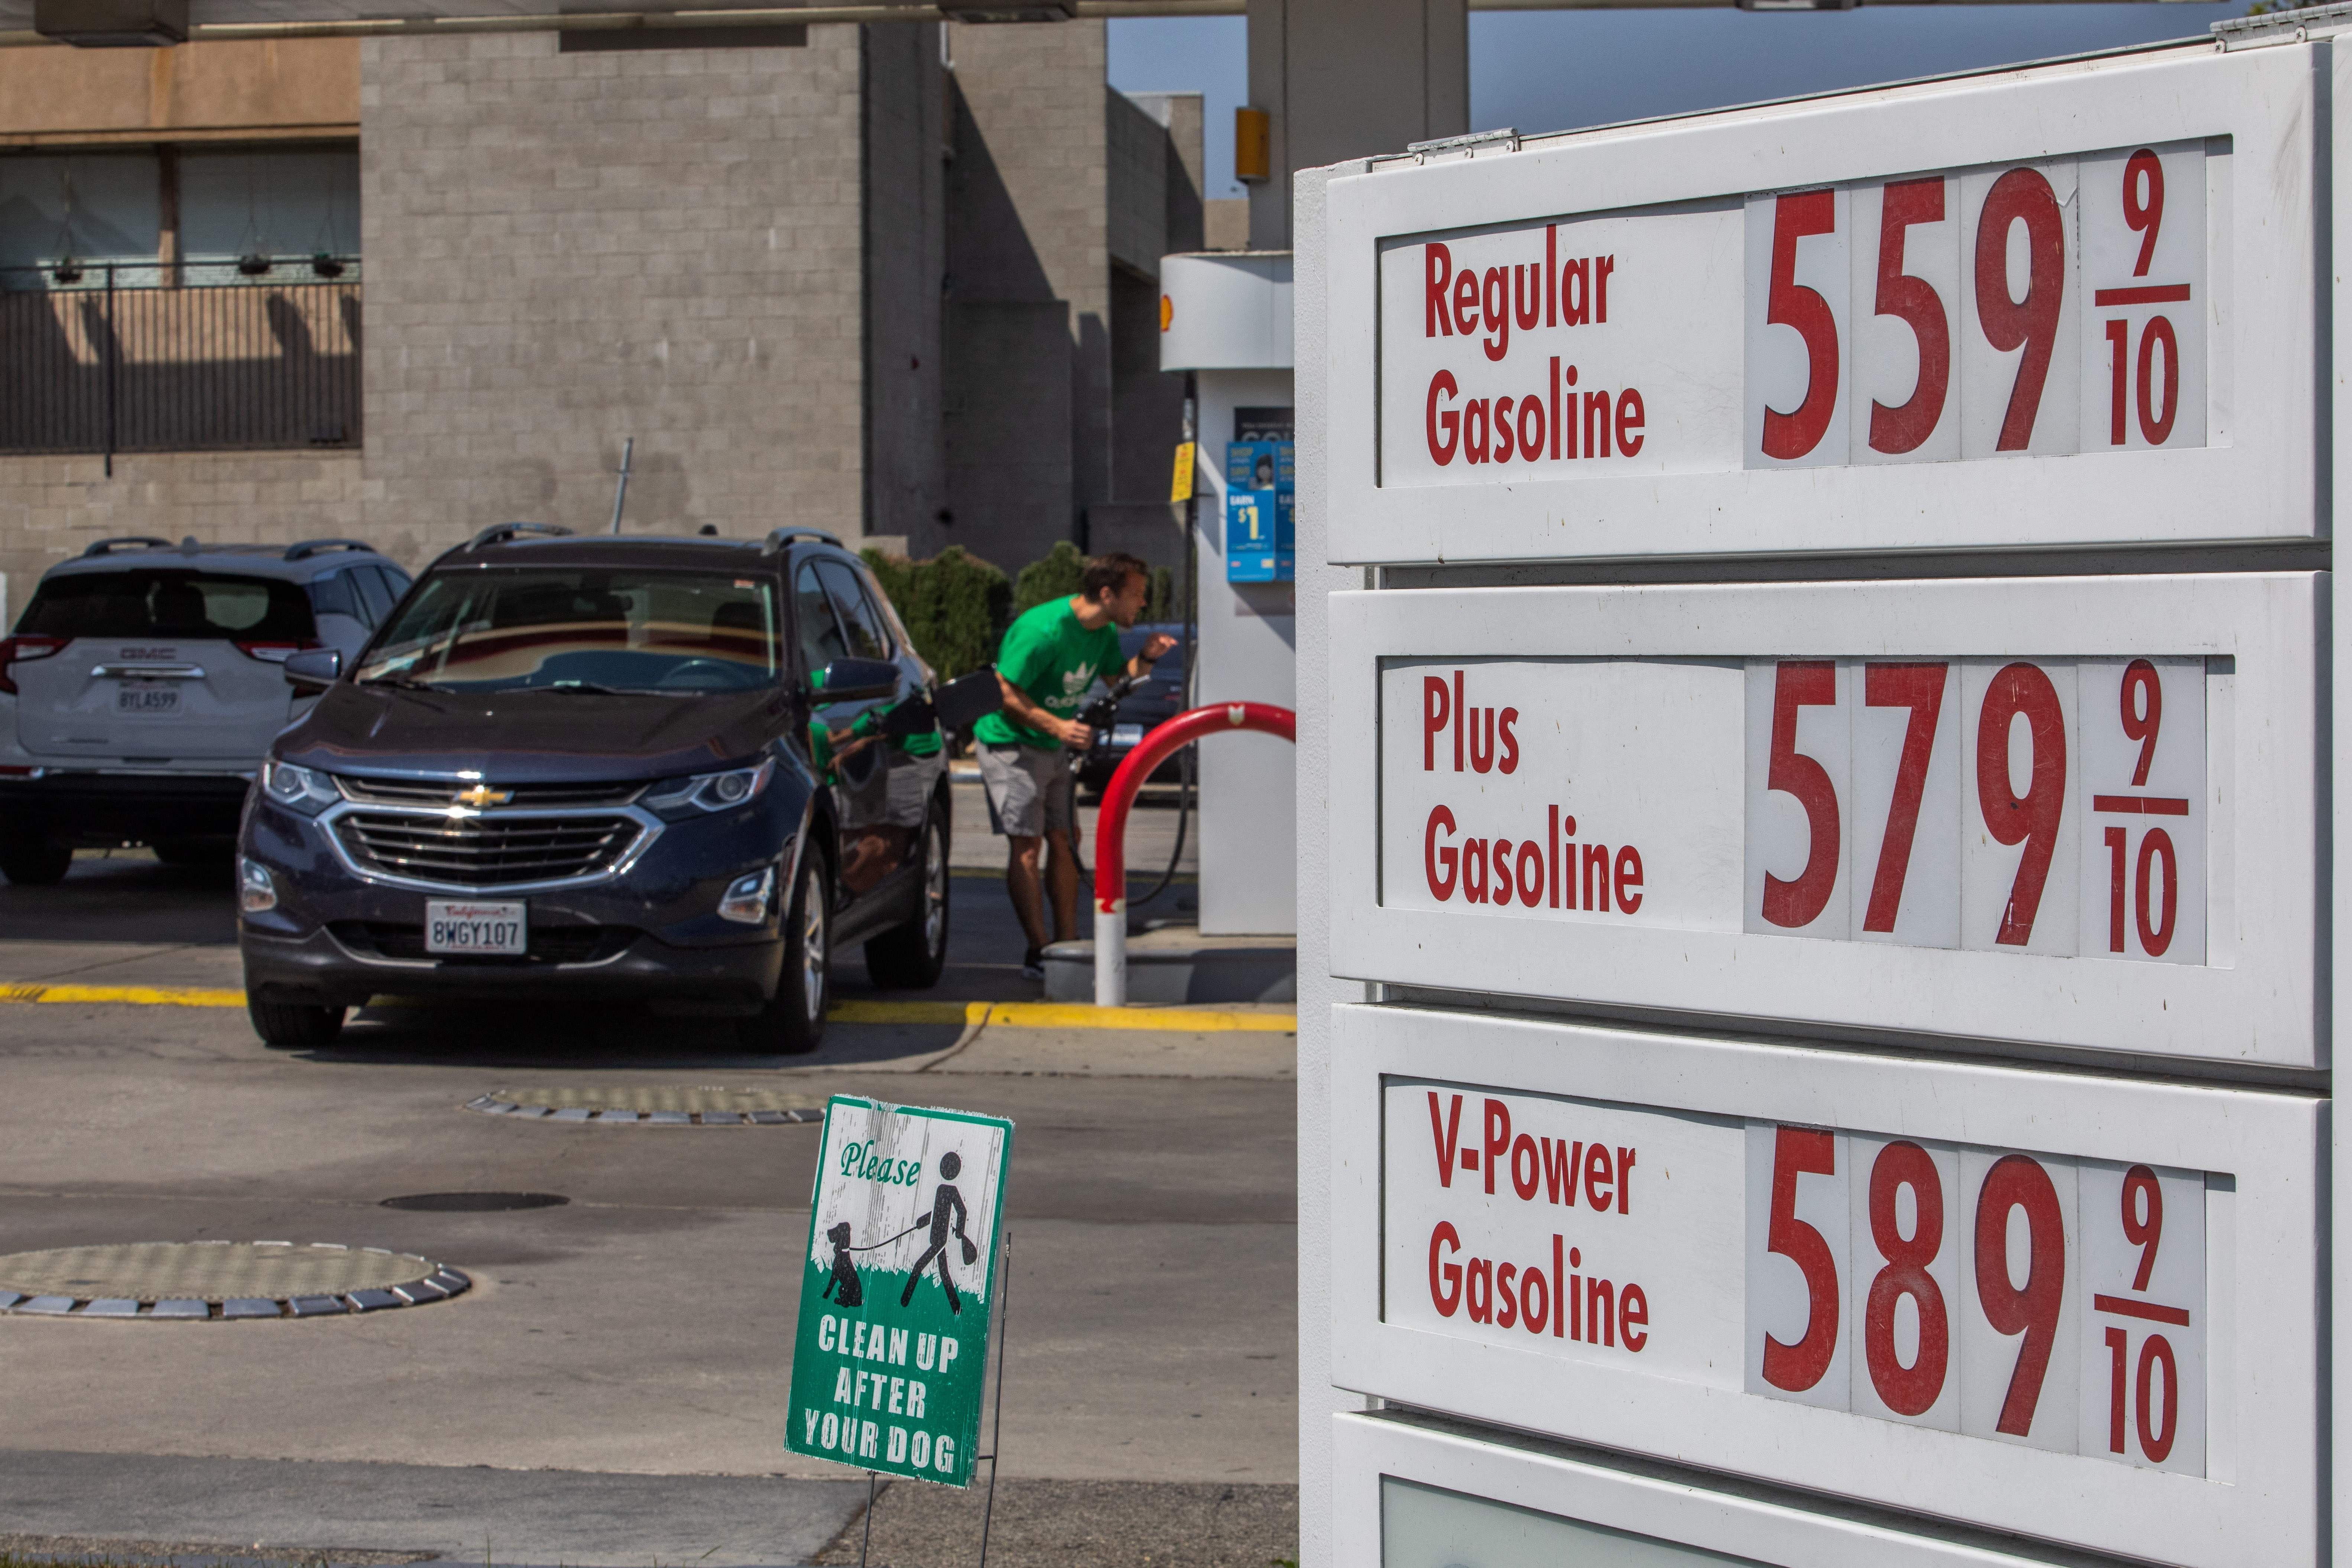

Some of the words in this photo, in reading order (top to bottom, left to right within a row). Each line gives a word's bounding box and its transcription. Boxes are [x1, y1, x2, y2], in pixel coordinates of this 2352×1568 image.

[2122, 147, 2164, 277] 9
[1425, 224, 1614, 362] Regular
[1761, 167, 2065, 460] 559
[1426, 356, 1645, 467] Gasoline
[2105, 315, 2179, 446] 10
[120, 647, 176, 659] GMC
[1424, 670, 1519, 775] Plus
[2121, 659, 2162, 786] 9
[1424, 804, 1644, 915] Gasoline
[1762, 660, 2066, 946] 579
[433, 921, 518, 946] 8WGY107
[2104, 826, 2177, 957] 10
[841, 1139, 921, 1187] Please
[1427, 1091, 1636, 1215] V-Power
[1428, 1220, 1649, 1352] Gasoline
[1762, 1124, 2065, 1438] 589
[2122, 1164, 2163, 1292] 9
[818, 1314, 909, 1366] CLEAN
[916, 1332, 959, 1374] UP
[833, 1366, 927, 1419] AFTER
[2105, 1326, 2178, 1464] 10
[805, 1408, 879, 1459] YOUR
[886, 1425, 955, 1474] DOG
